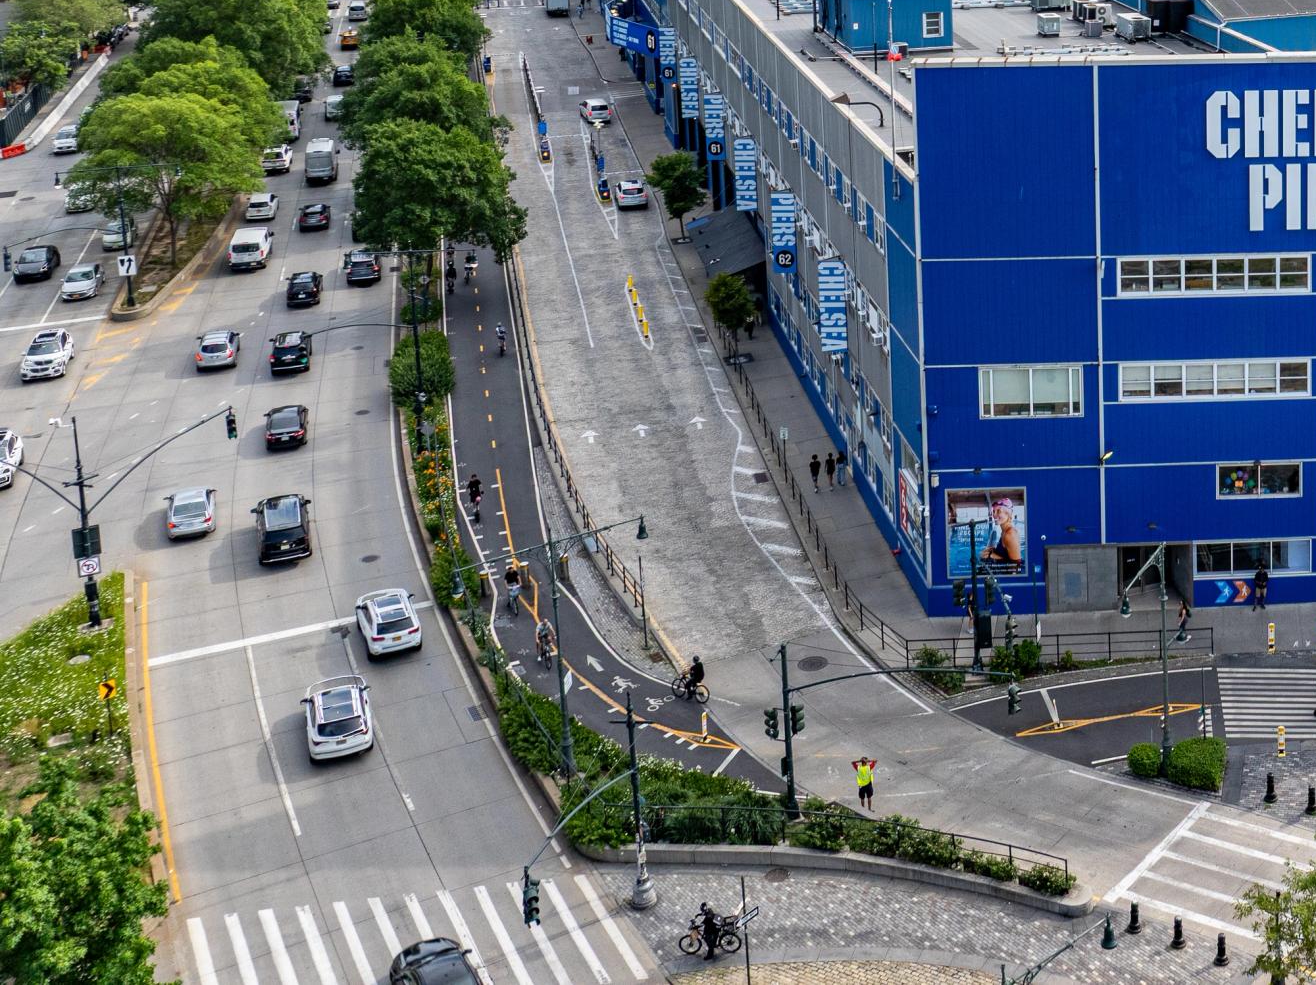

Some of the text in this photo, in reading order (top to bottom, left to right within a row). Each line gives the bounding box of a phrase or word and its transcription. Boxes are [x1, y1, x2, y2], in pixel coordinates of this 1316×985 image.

[647, 34, 655, 49] 61
[659, 27, 675, 77] PIERS 61
[680, 58, 699, 118] CHELSEA
[704, 94, 724, 153] PIERS 61
[734, 138, 757, 211] CHELSEA
[771, 193, 795, 265] PIERS 62
[817, 262, 848, 352] CHELSEA
